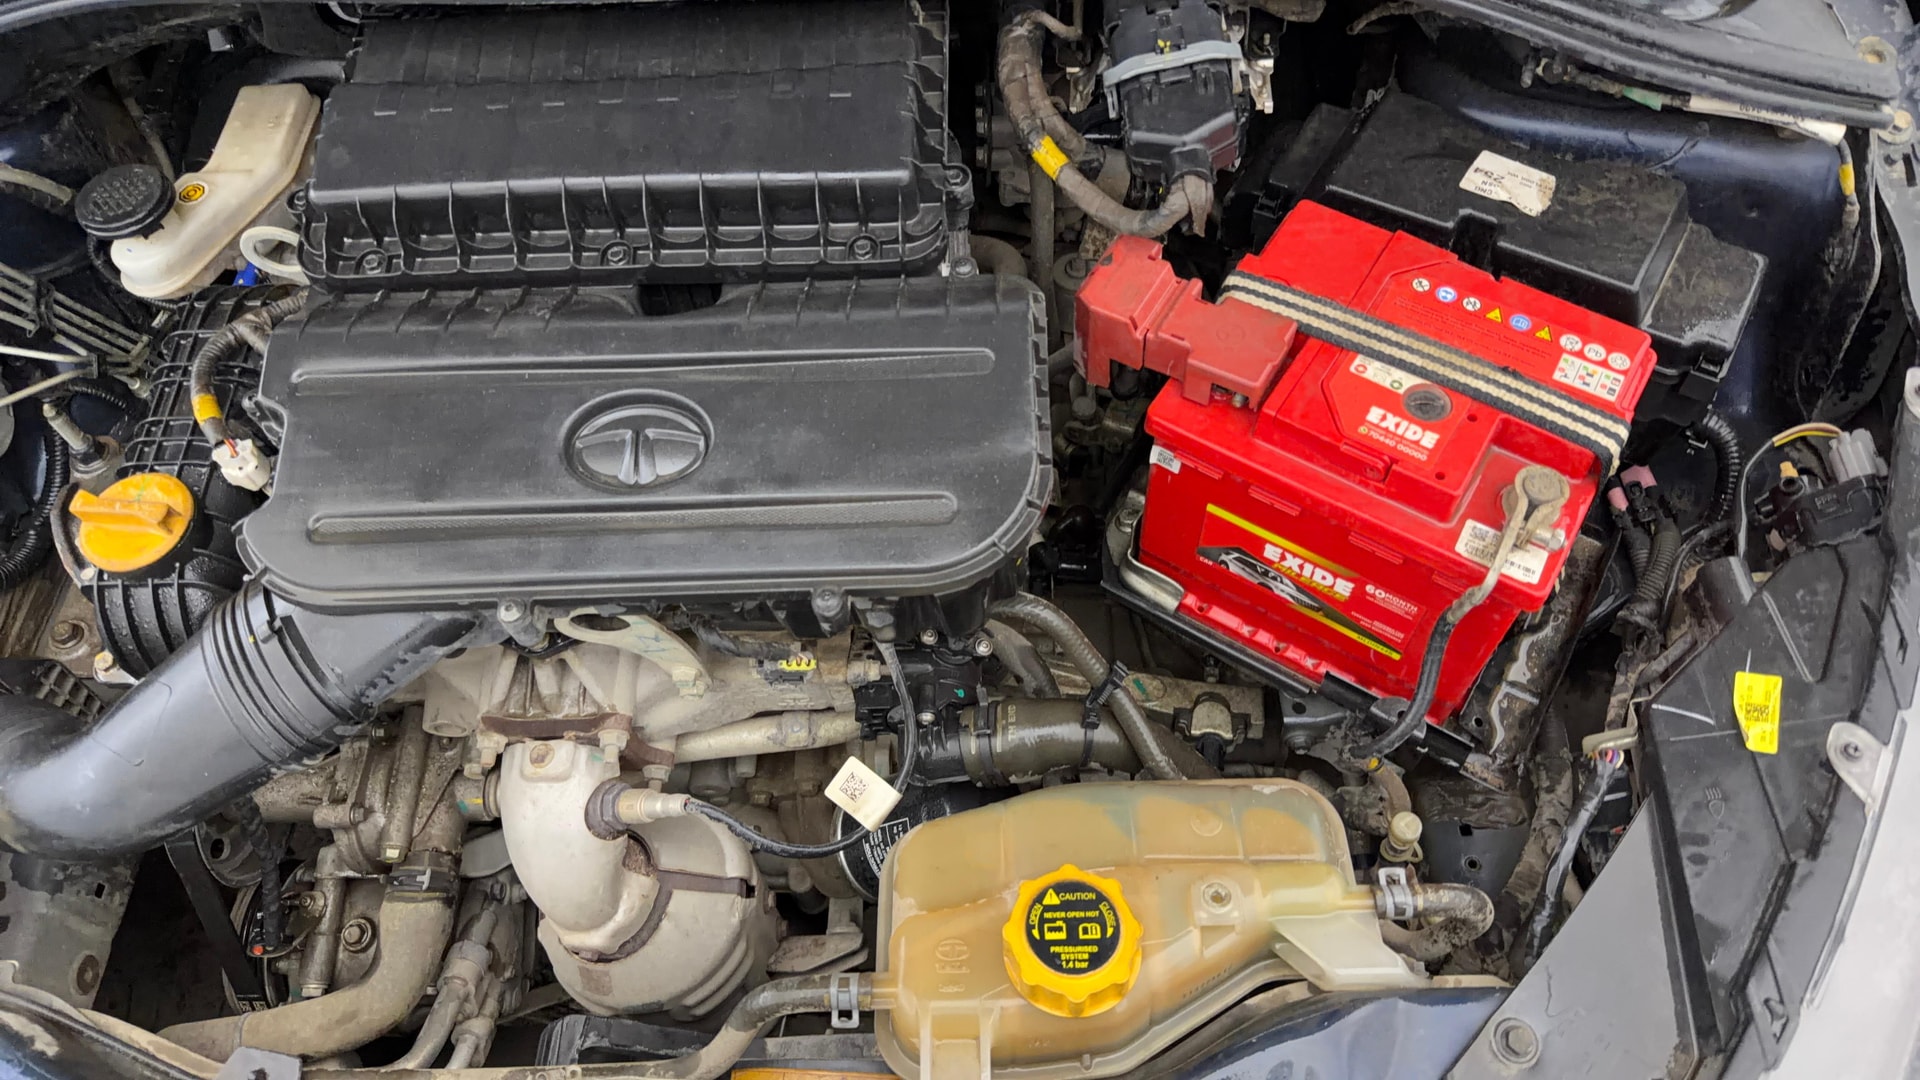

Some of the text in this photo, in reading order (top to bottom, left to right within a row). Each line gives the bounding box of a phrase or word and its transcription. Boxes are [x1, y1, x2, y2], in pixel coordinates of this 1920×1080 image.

[1587, 346, 1602, 358] Pb
[1365, 405, 1440, 449] EXIDE
[1368, 430, 1396, 447] 70440
[1397, 444, 1428, 461] 00000
[1263, 543, 1355, 597] EXIDE
[1365, 584, 1386, 599] 60
[1385, 592, 1418, 612] MONTH
[1059, 892, 1096, 900] CAUTION
[1029, 902, 1042, 925] OPEN
[1044, 911, 1065, 919] NEVER
[1100, 901, 1116, 927] CLOSE
[1050, 945, 1098, 953] PRESSURISED
[1061, 960, 1089, 968] 1.4 bar
